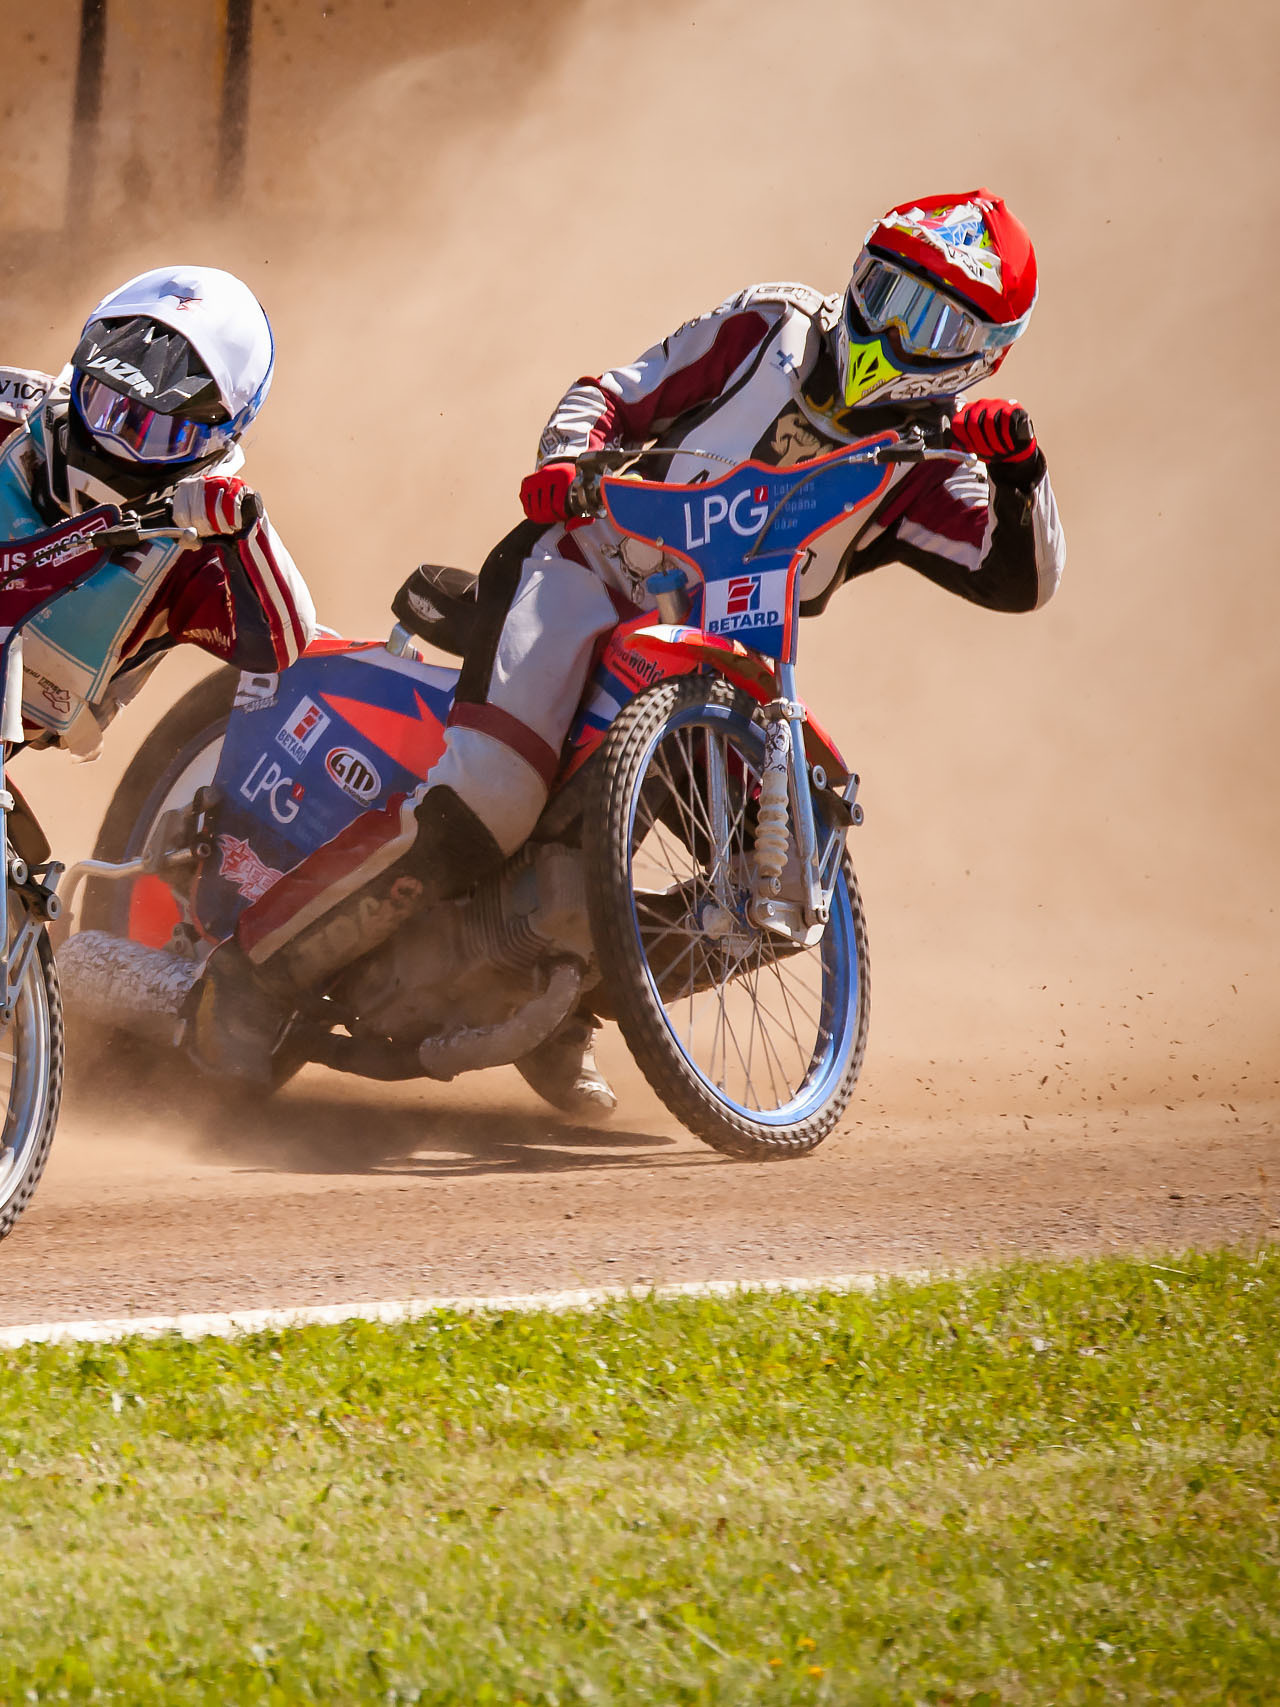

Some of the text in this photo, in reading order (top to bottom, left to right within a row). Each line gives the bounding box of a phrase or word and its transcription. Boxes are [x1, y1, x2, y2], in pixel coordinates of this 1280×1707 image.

[86, 355, 155, 398] LAZER
[684, 488, 768, 550] LPG
[708, 611, 779, 633] BETARD
[277, 729, 307, 761] BETARD
[240, 752, 300, 824] LPG
[330, 753, 375, 792] GM
